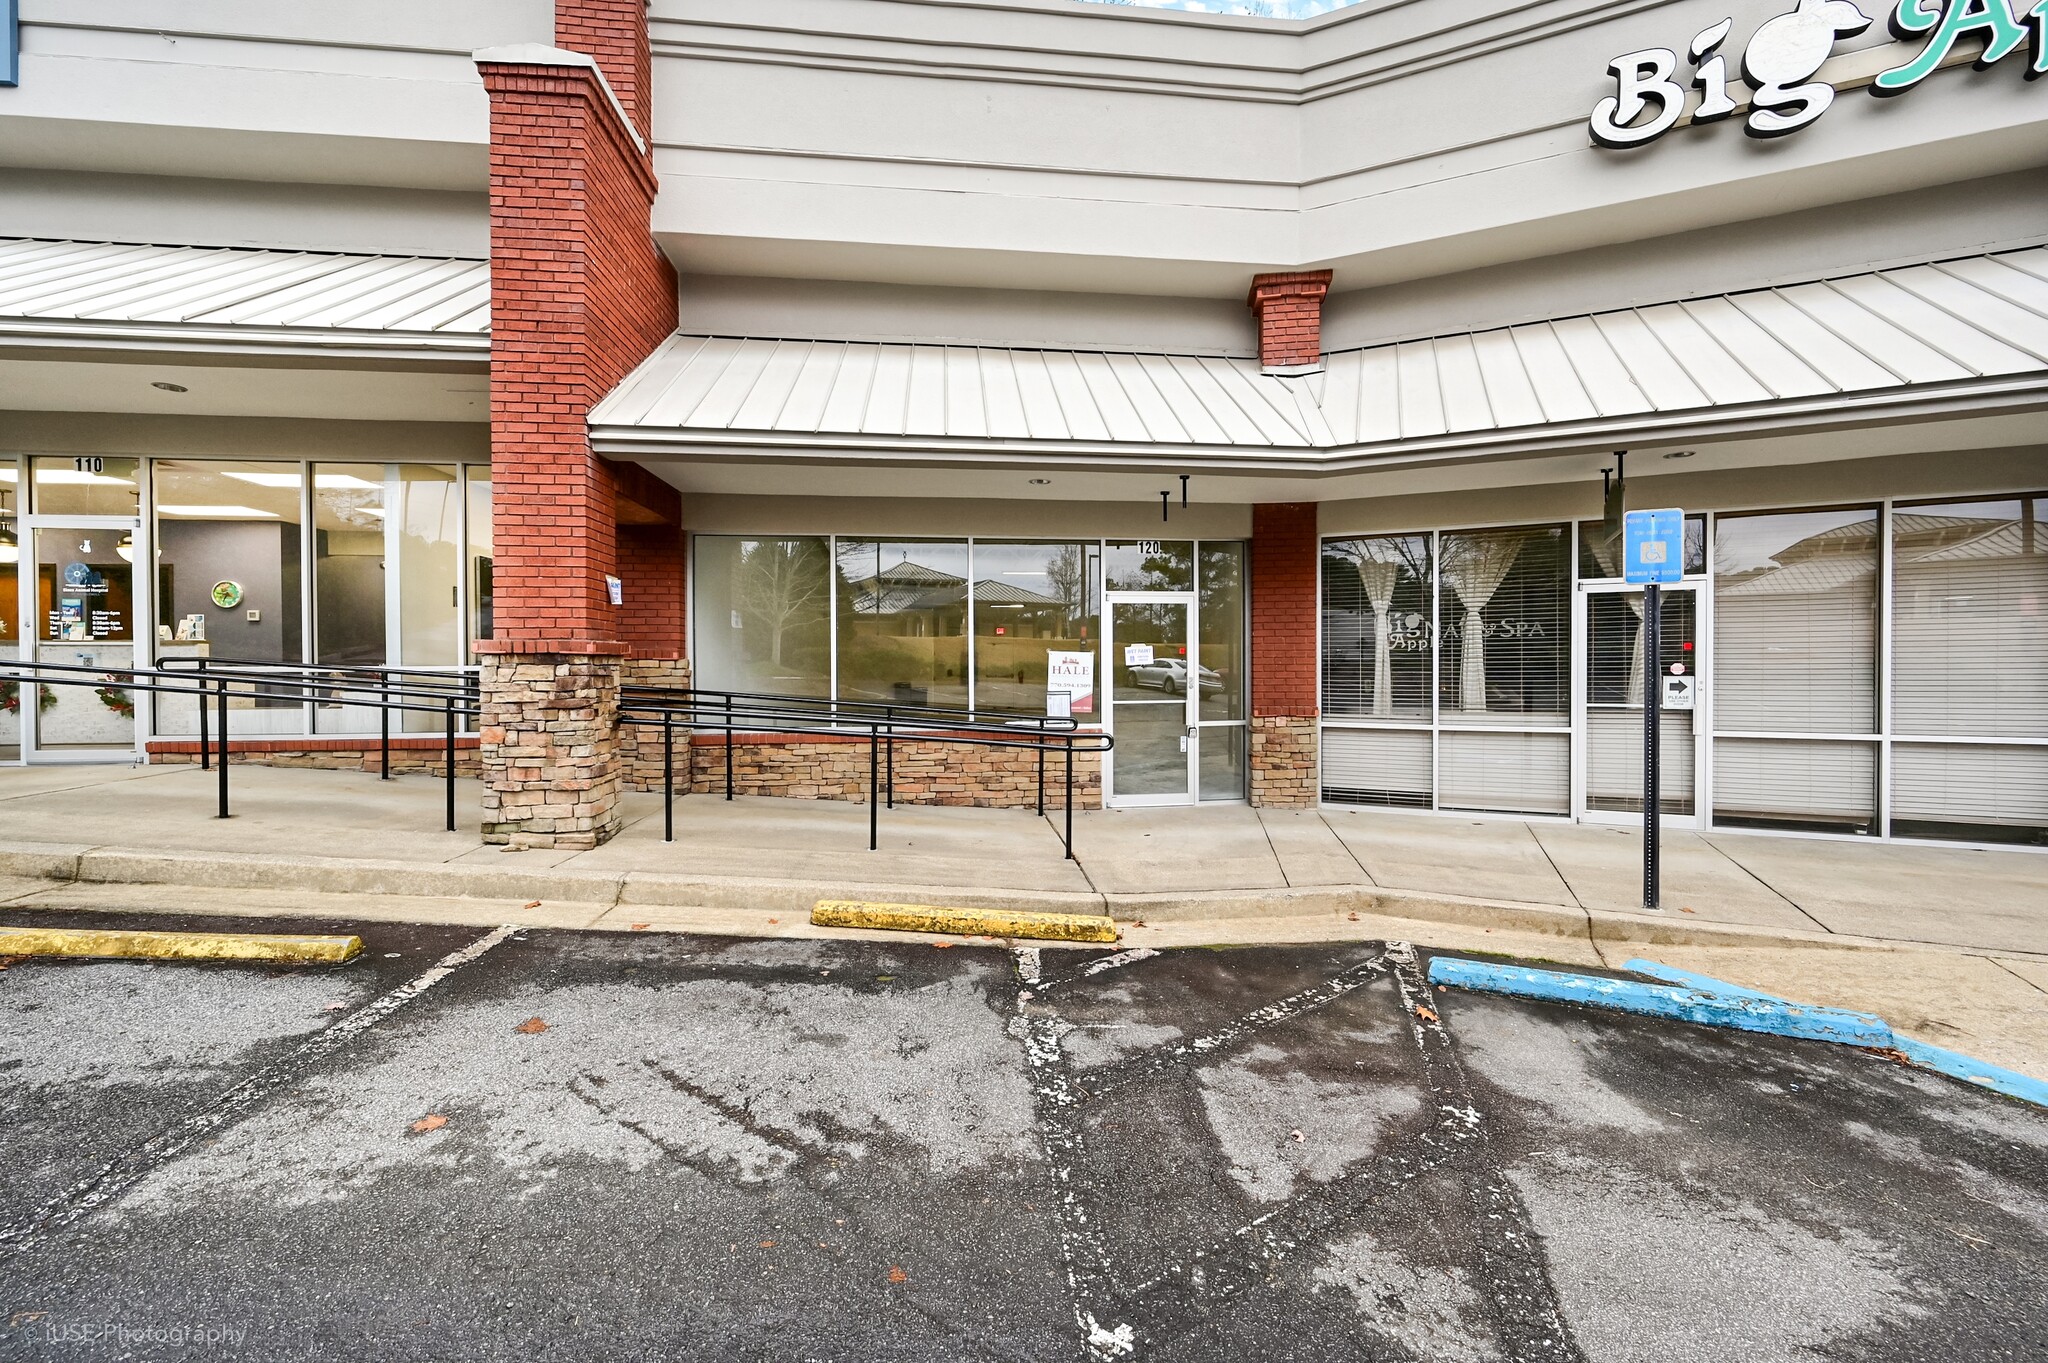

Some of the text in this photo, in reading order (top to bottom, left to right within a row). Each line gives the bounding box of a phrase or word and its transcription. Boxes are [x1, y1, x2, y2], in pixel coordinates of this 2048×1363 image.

[1589, 0, 1874, 148] Big
[75, 457, 102, 472] 110
[1138, 541, 1159, 554] 120
[1052, 665, 1090, 675] HALE
